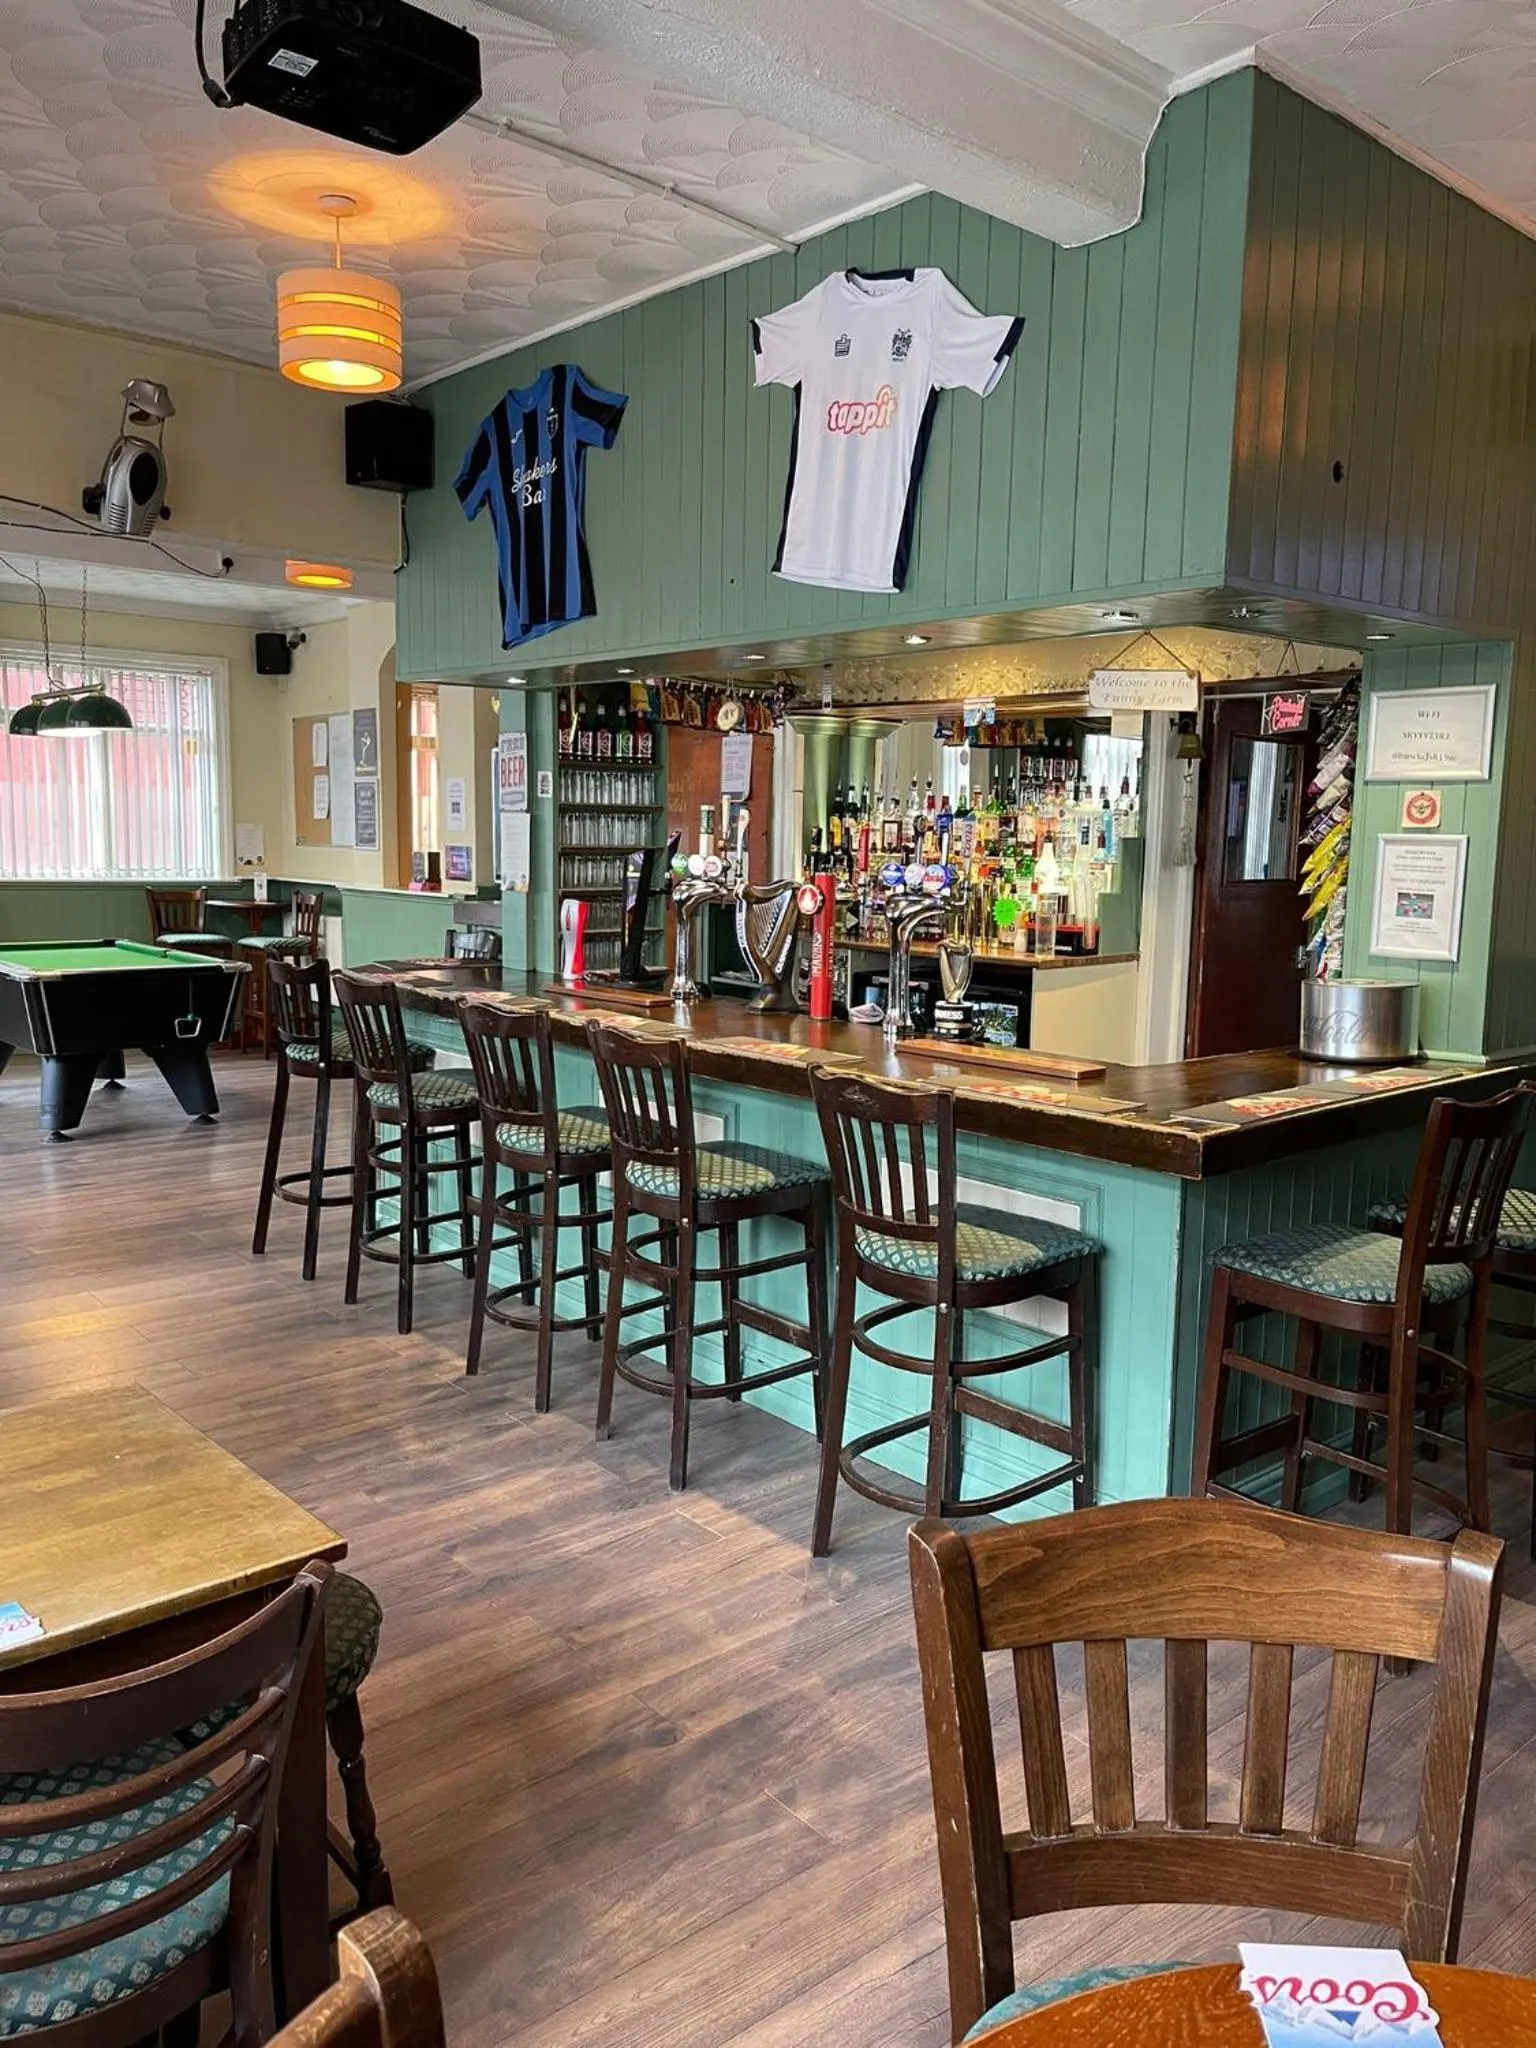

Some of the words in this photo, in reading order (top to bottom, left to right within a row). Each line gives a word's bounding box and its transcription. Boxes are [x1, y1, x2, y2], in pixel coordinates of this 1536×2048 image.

[827, 384, 898, 436] tappit
[511, 456, 558, 494] Shakers
[1096, 676, 1148, 688] Welcome
[1153, 678, 1168, 687] to
[1171, 677, 1192, 689] the
[1103, 693, 1145, 706] Funny
[1148, 693, 1184, 704] Farm
[500, 755, 525, 788] BEER
[1249, 1975, 1431, 2024] Coors
